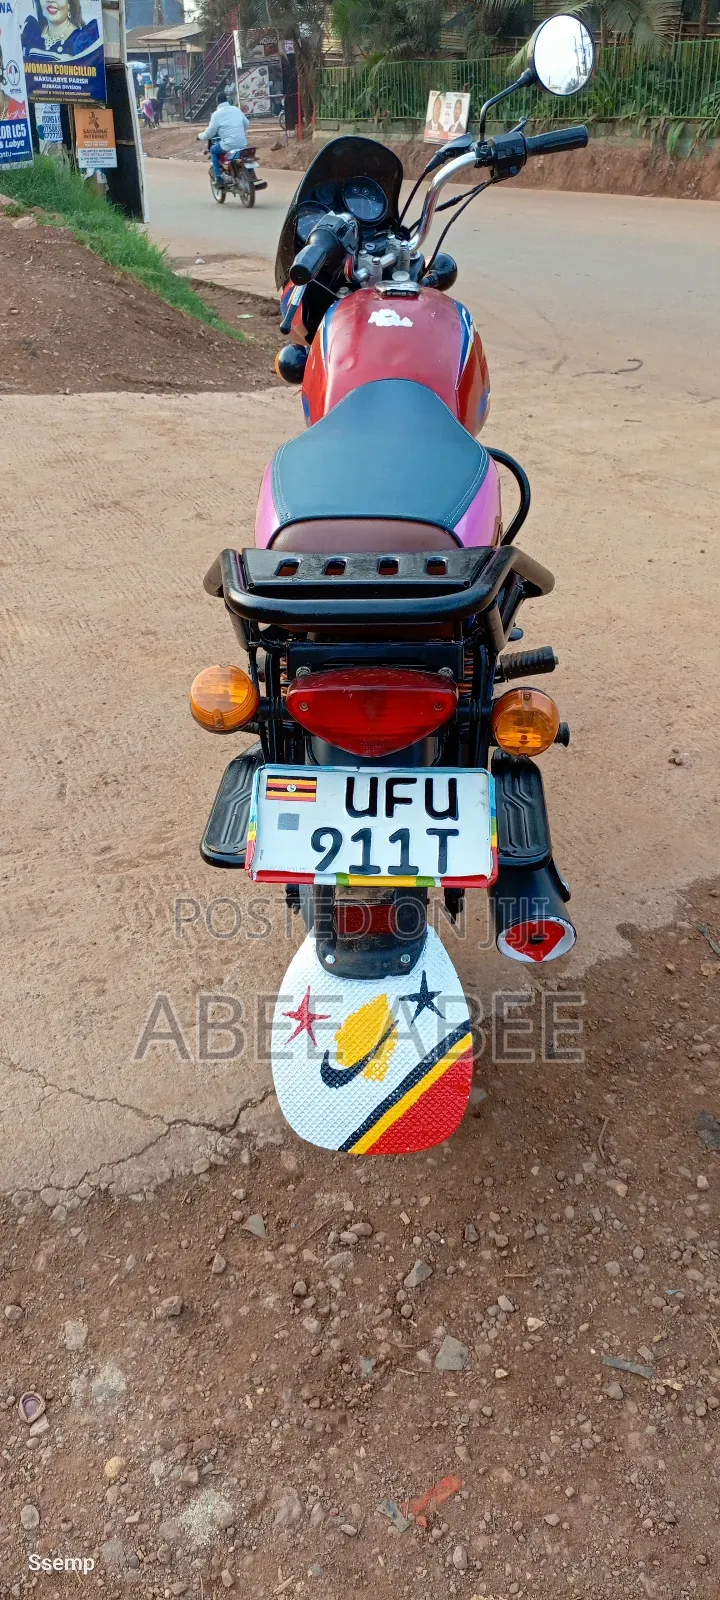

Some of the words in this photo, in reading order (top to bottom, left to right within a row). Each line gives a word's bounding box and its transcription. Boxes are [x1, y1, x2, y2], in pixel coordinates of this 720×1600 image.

[25, 63, 53, 74] WOMAN
[54, 65, 96, 77] COUNCILLOR
[0, 125, 12, 139] OR
[12, 124, 27, 138] LC5
[5, 139, 25, 149] Lubya
[345, 776, 459, 821] UFU
[310, 827, 460, 876] 911T
